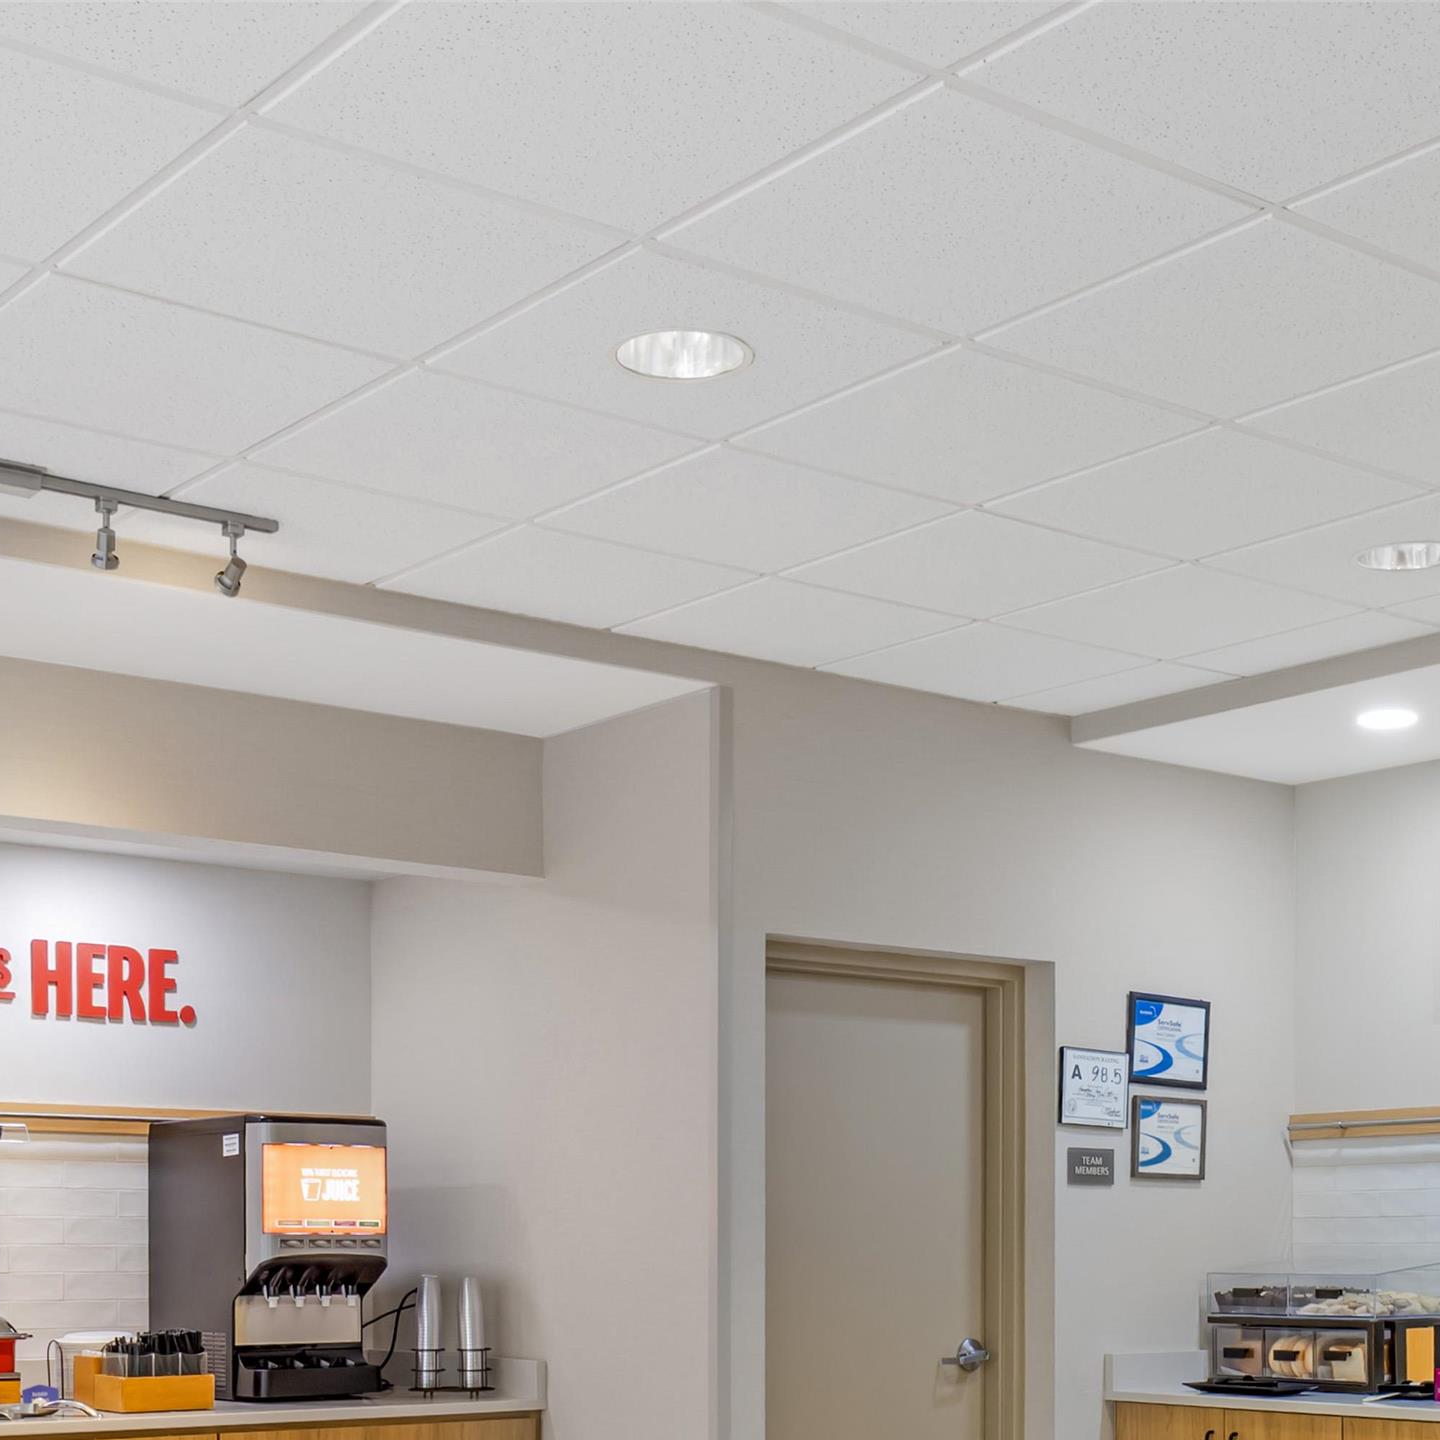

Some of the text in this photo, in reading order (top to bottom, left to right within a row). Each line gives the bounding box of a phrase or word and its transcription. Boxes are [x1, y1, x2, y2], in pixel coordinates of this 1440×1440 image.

[30, 939, 197, 1025] HERE.
[1072, 1064, 1122, 1085] A 98.5
[1075, 1166, 1110, 1176] MEMBERS
[1082, 1156, 1103, 1166] TEAM
[322, 1179, 360, 1201] JUICE
